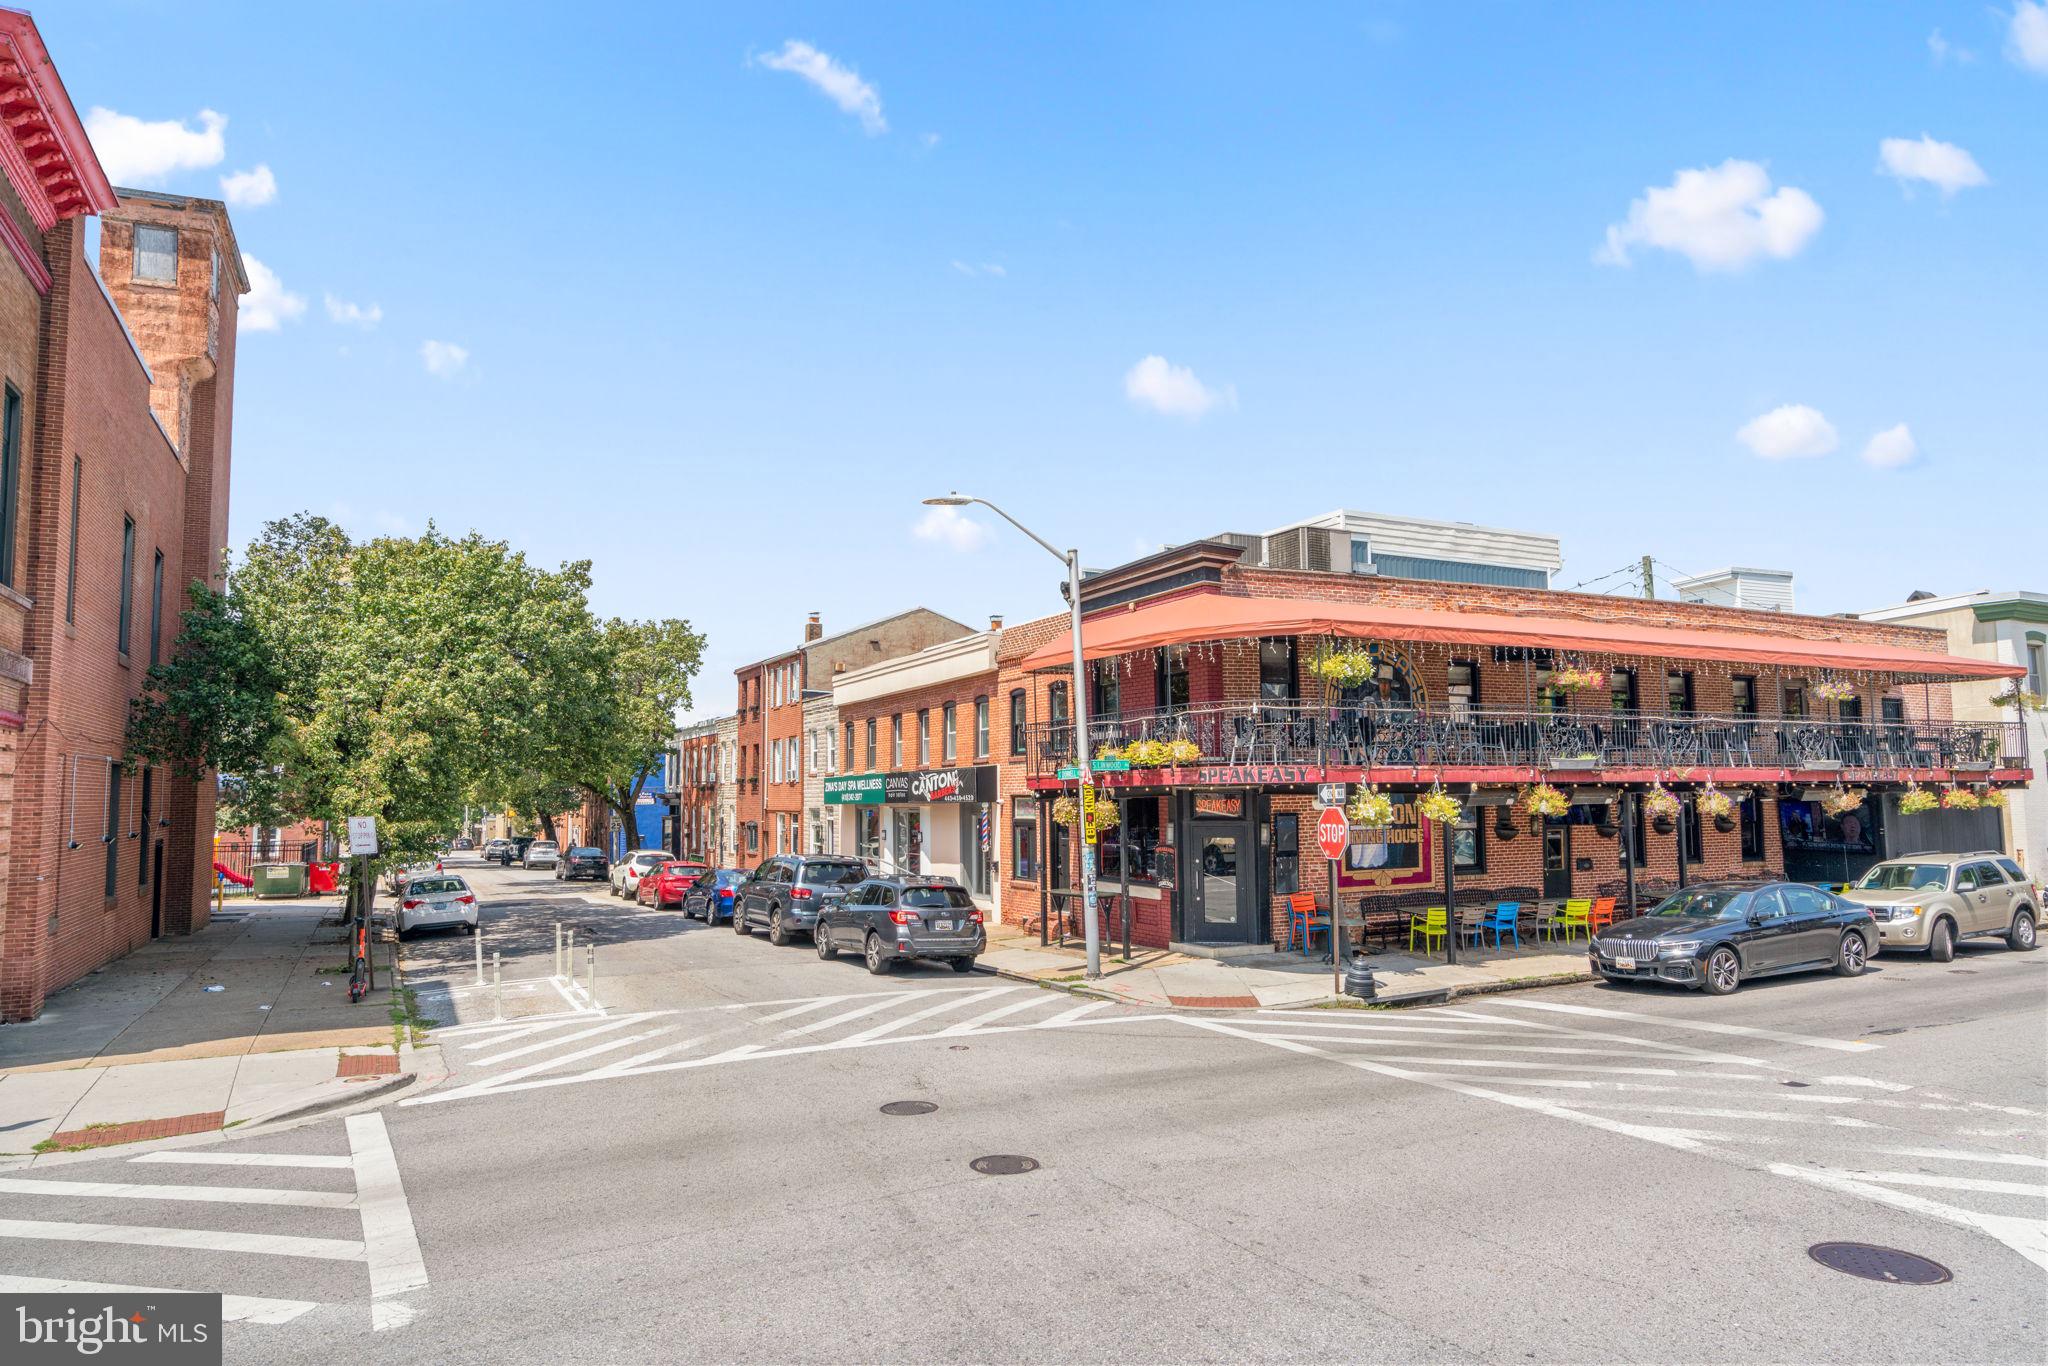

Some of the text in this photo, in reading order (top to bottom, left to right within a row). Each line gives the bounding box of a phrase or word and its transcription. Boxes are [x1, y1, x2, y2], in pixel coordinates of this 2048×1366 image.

[1199, 766, 1309, 782] SPEAKEASY
[838, 781, 847, 791] DAY
[847, 780, 857, 791] SPA
[856, 778, 882, 790] WELLNESS
[886, 777, 909, 789] CANVAS
[911, 771, 957, 795] CANTON
[1085, 788, 1094, 811] KIND
[1196, 798, 1240, 812] SPEAKEASY
[357, 821, 367, 829] NO
[611, 822, 621, 830] 25
[1319, 823, 1345, 843] STOP
[1349, 828, 1425, 844] INING HOUSE
